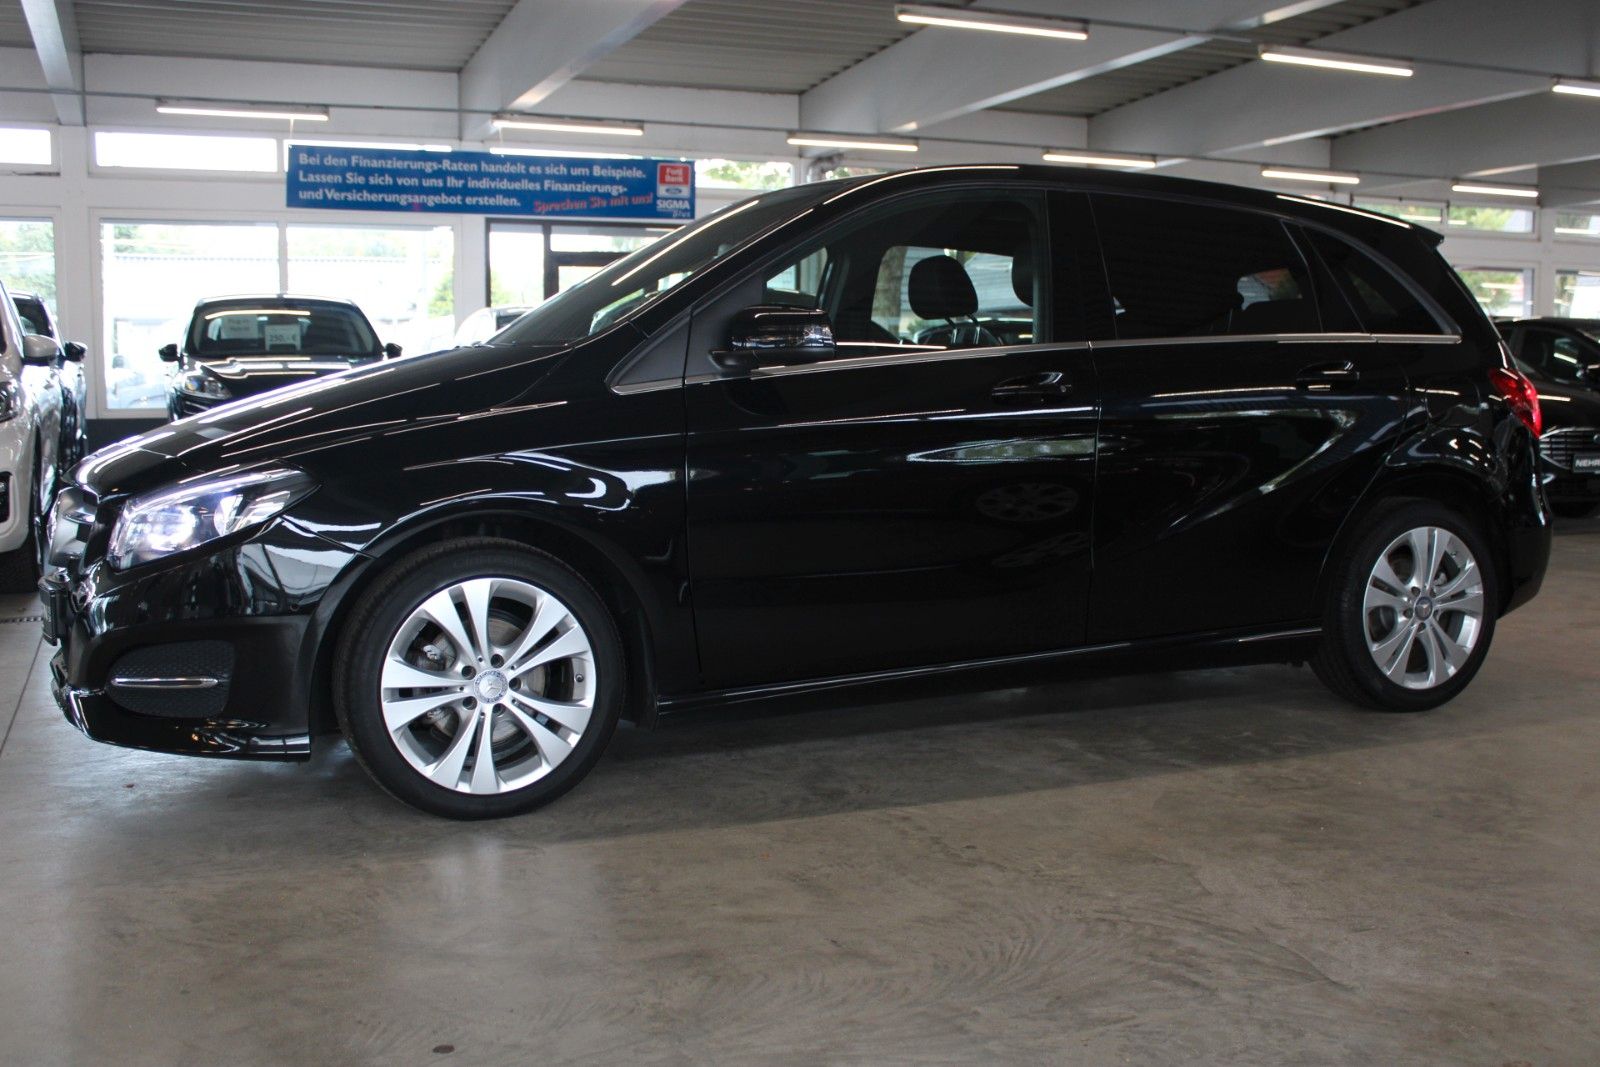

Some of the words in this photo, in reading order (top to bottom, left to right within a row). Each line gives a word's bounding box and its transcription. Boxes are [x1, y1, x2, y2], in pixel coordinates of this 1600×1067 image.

[299, 153, 320, 165] Bei
[323, 155, 347, 167] den
[351, 157, 477, 173] Finanzierungs-Raten
[481, 161, 526, 174] handelt
[529, 166, 541, 175] es
[545, 163, 567, 176] sich
[570, 167, 590, 177] um
[593, 165, 646, 180] Beispiele.
[300, 172, 342, 184] Lassen
[346, 174, 366, 185] Sie
[368, 174, 393, 187] sich
[397, 178, 419, 188] von
[422, 179, 443, 189] uns
[447, 176, 463, 188] Ihr
[467, 177, 540, 192] individuelles
[543, 181, 627, 196] Finanzierungs-
[299, 189, 322, 200] und
[324, 190, 462, 207] Versicherungsangebot
[465, 195, 521, 207] erstellen.
[656, 199, 690, 209] SIGMA
